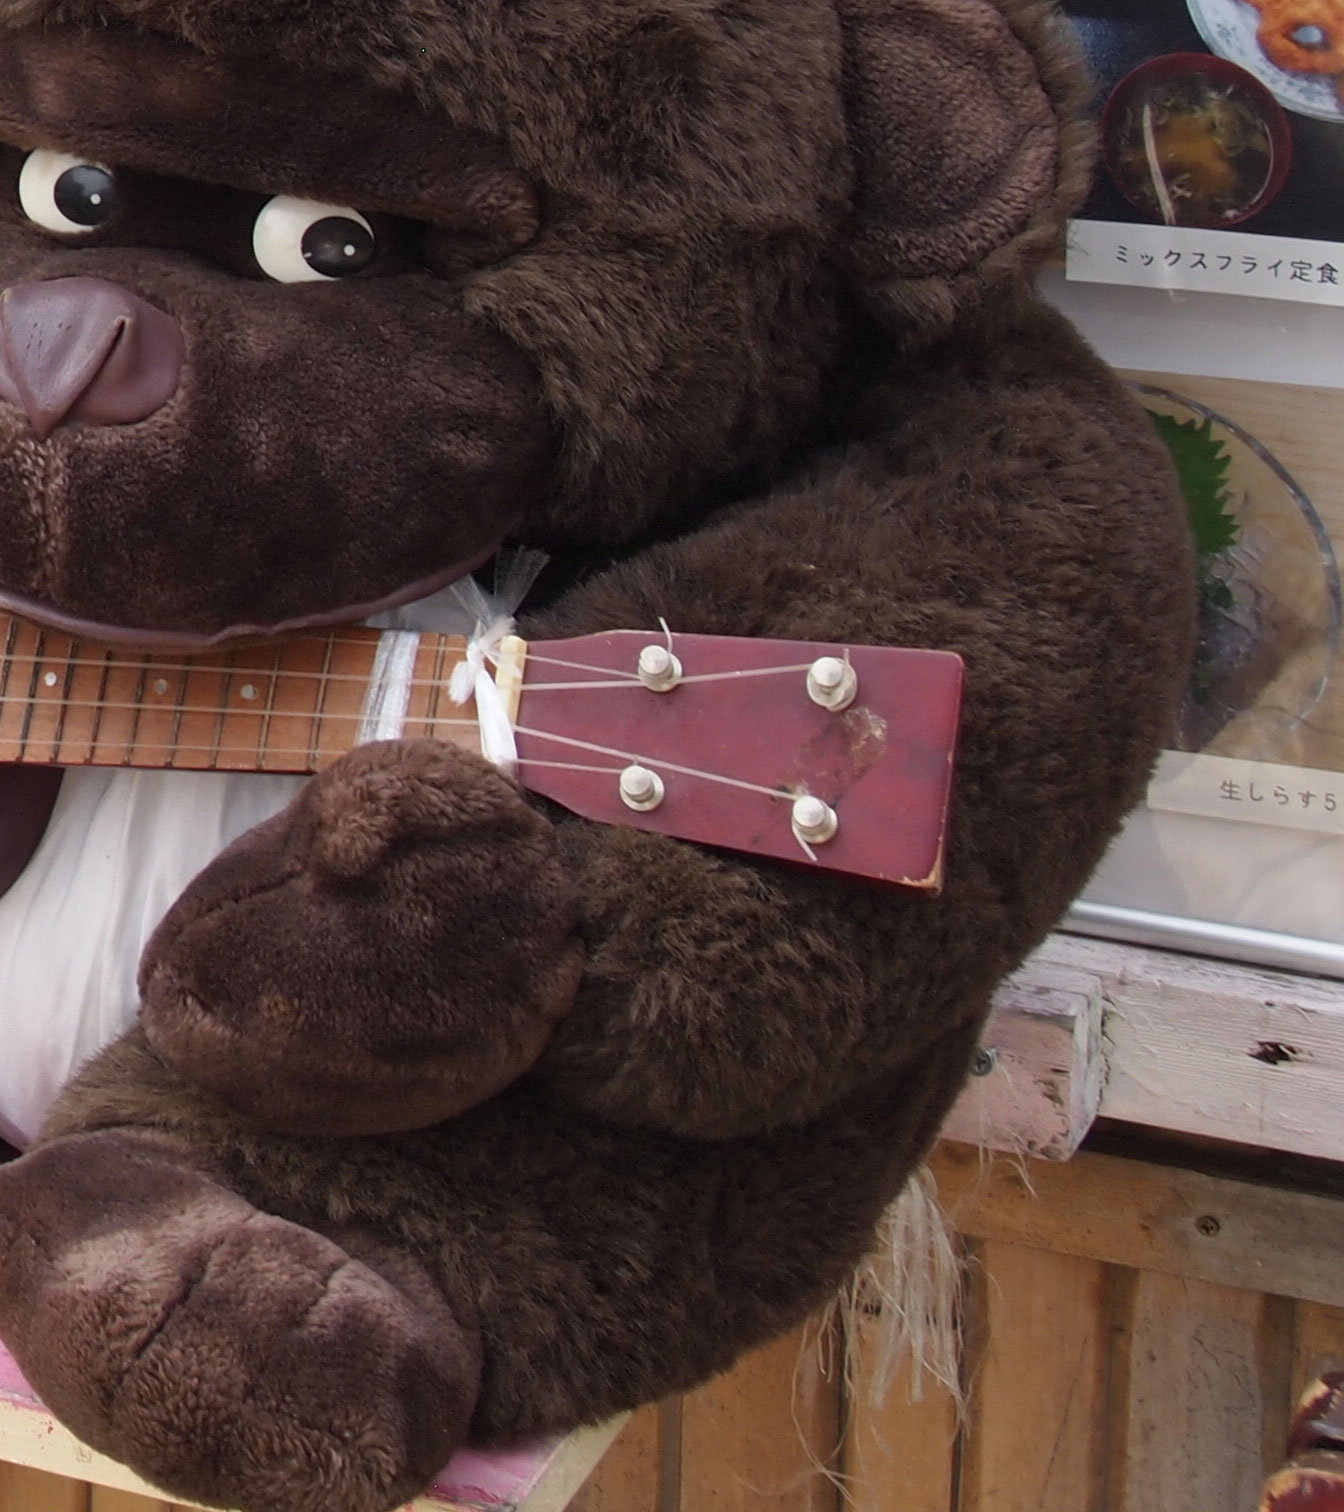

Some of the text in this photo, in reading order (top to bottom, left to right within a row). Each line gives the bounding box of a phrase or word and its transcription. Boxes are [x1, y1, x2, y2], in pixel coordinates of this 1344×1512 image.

[1114, 244, 1340, 286] ミックスフライ定食
